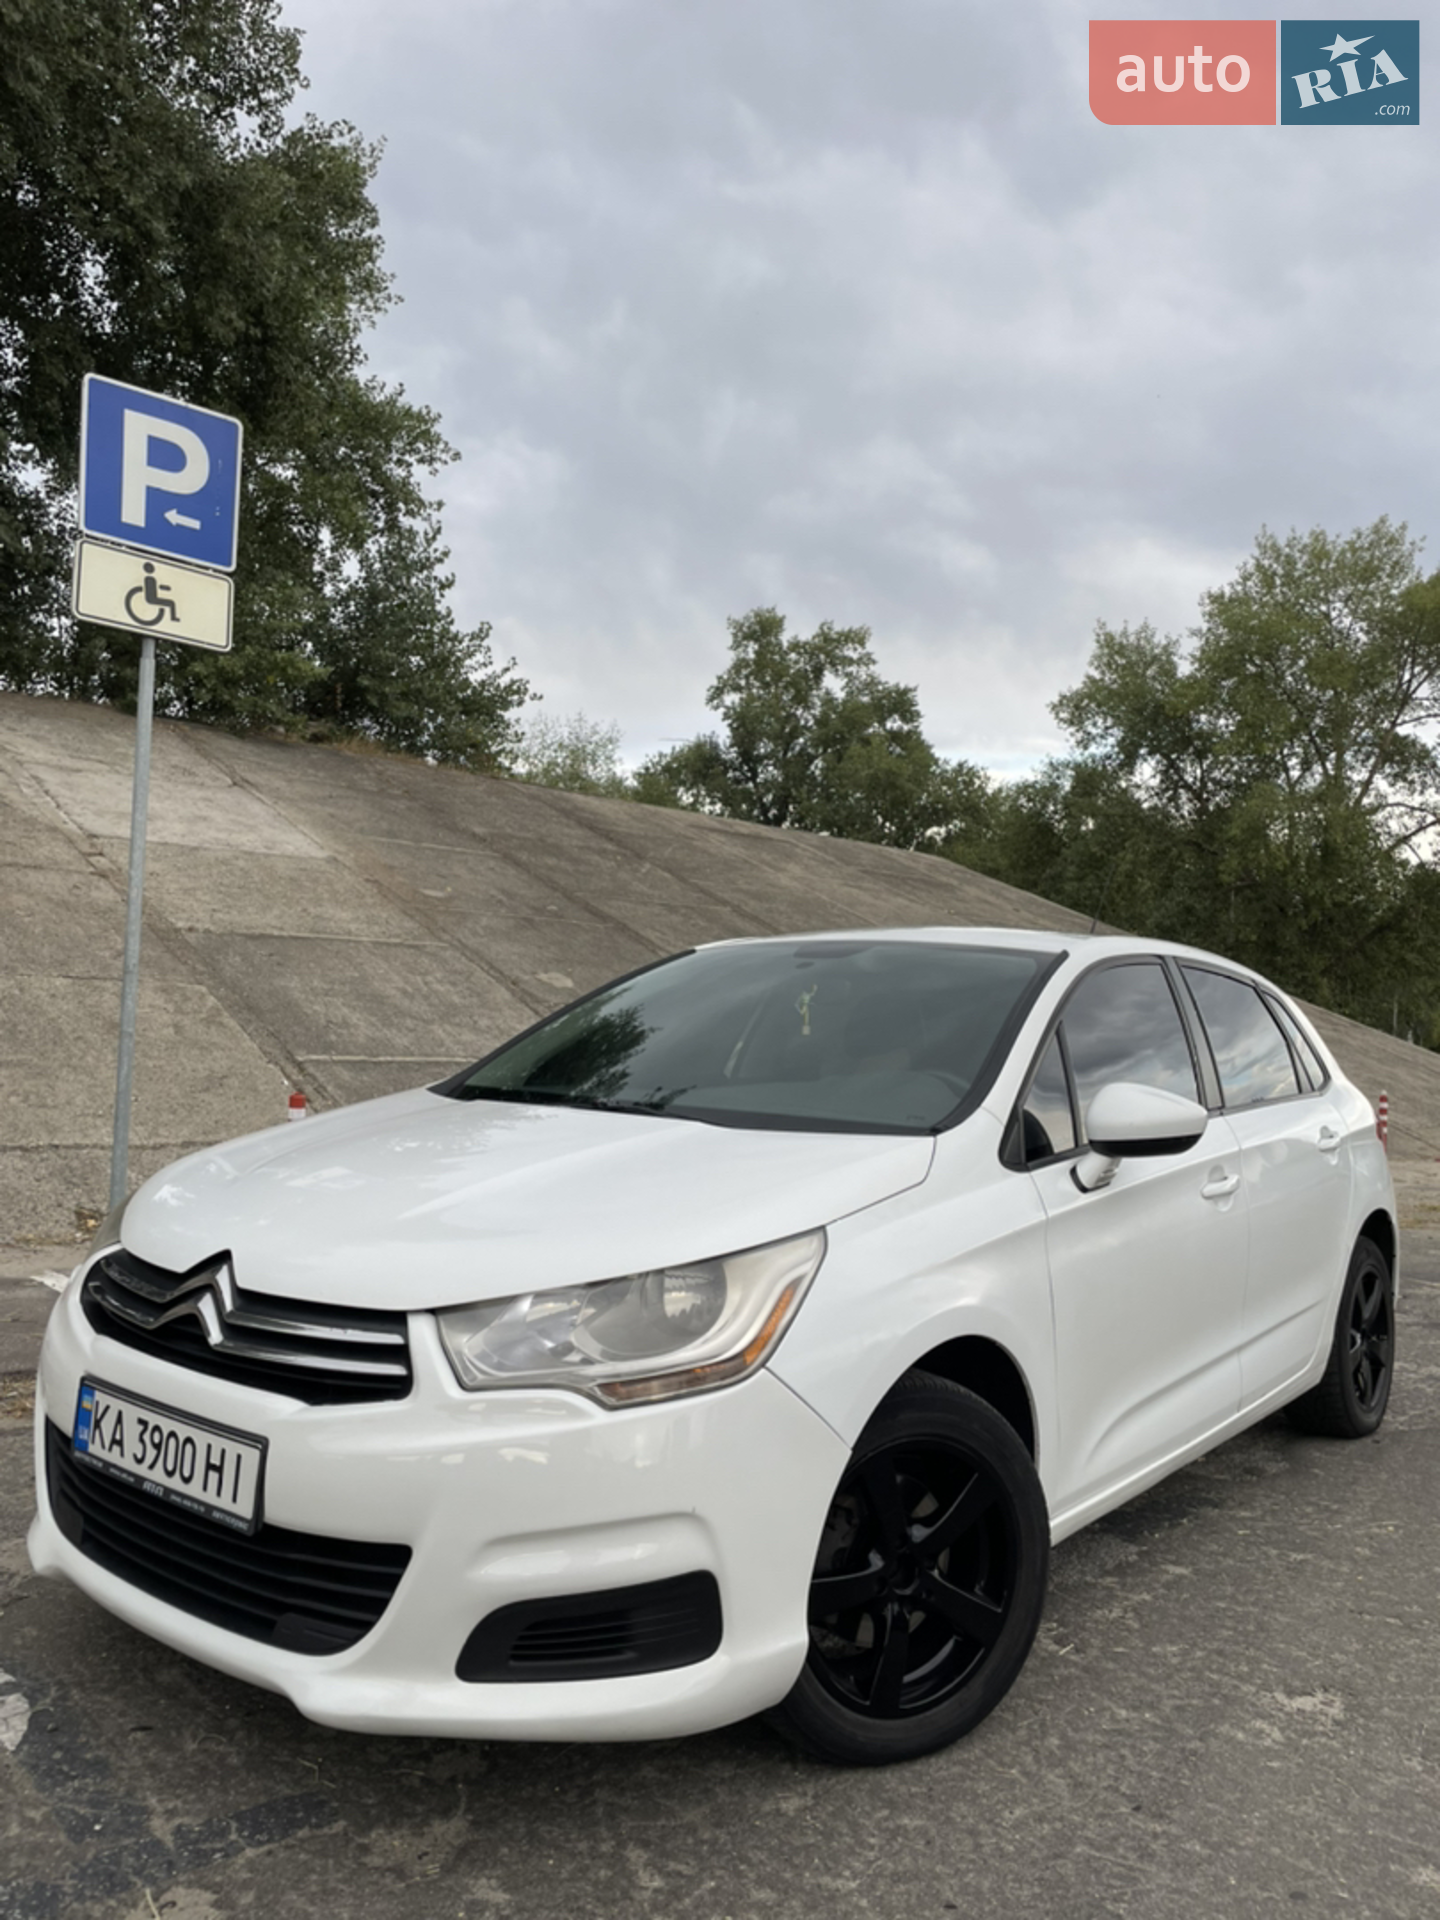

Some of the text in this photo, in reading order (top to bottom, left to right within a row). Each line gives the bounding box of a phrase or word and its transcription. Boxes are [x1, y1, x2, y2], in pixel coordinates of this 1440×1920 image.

[120, 408, 210, 528] P
[91, 1400, 242, 1505] KA 3900 HI
